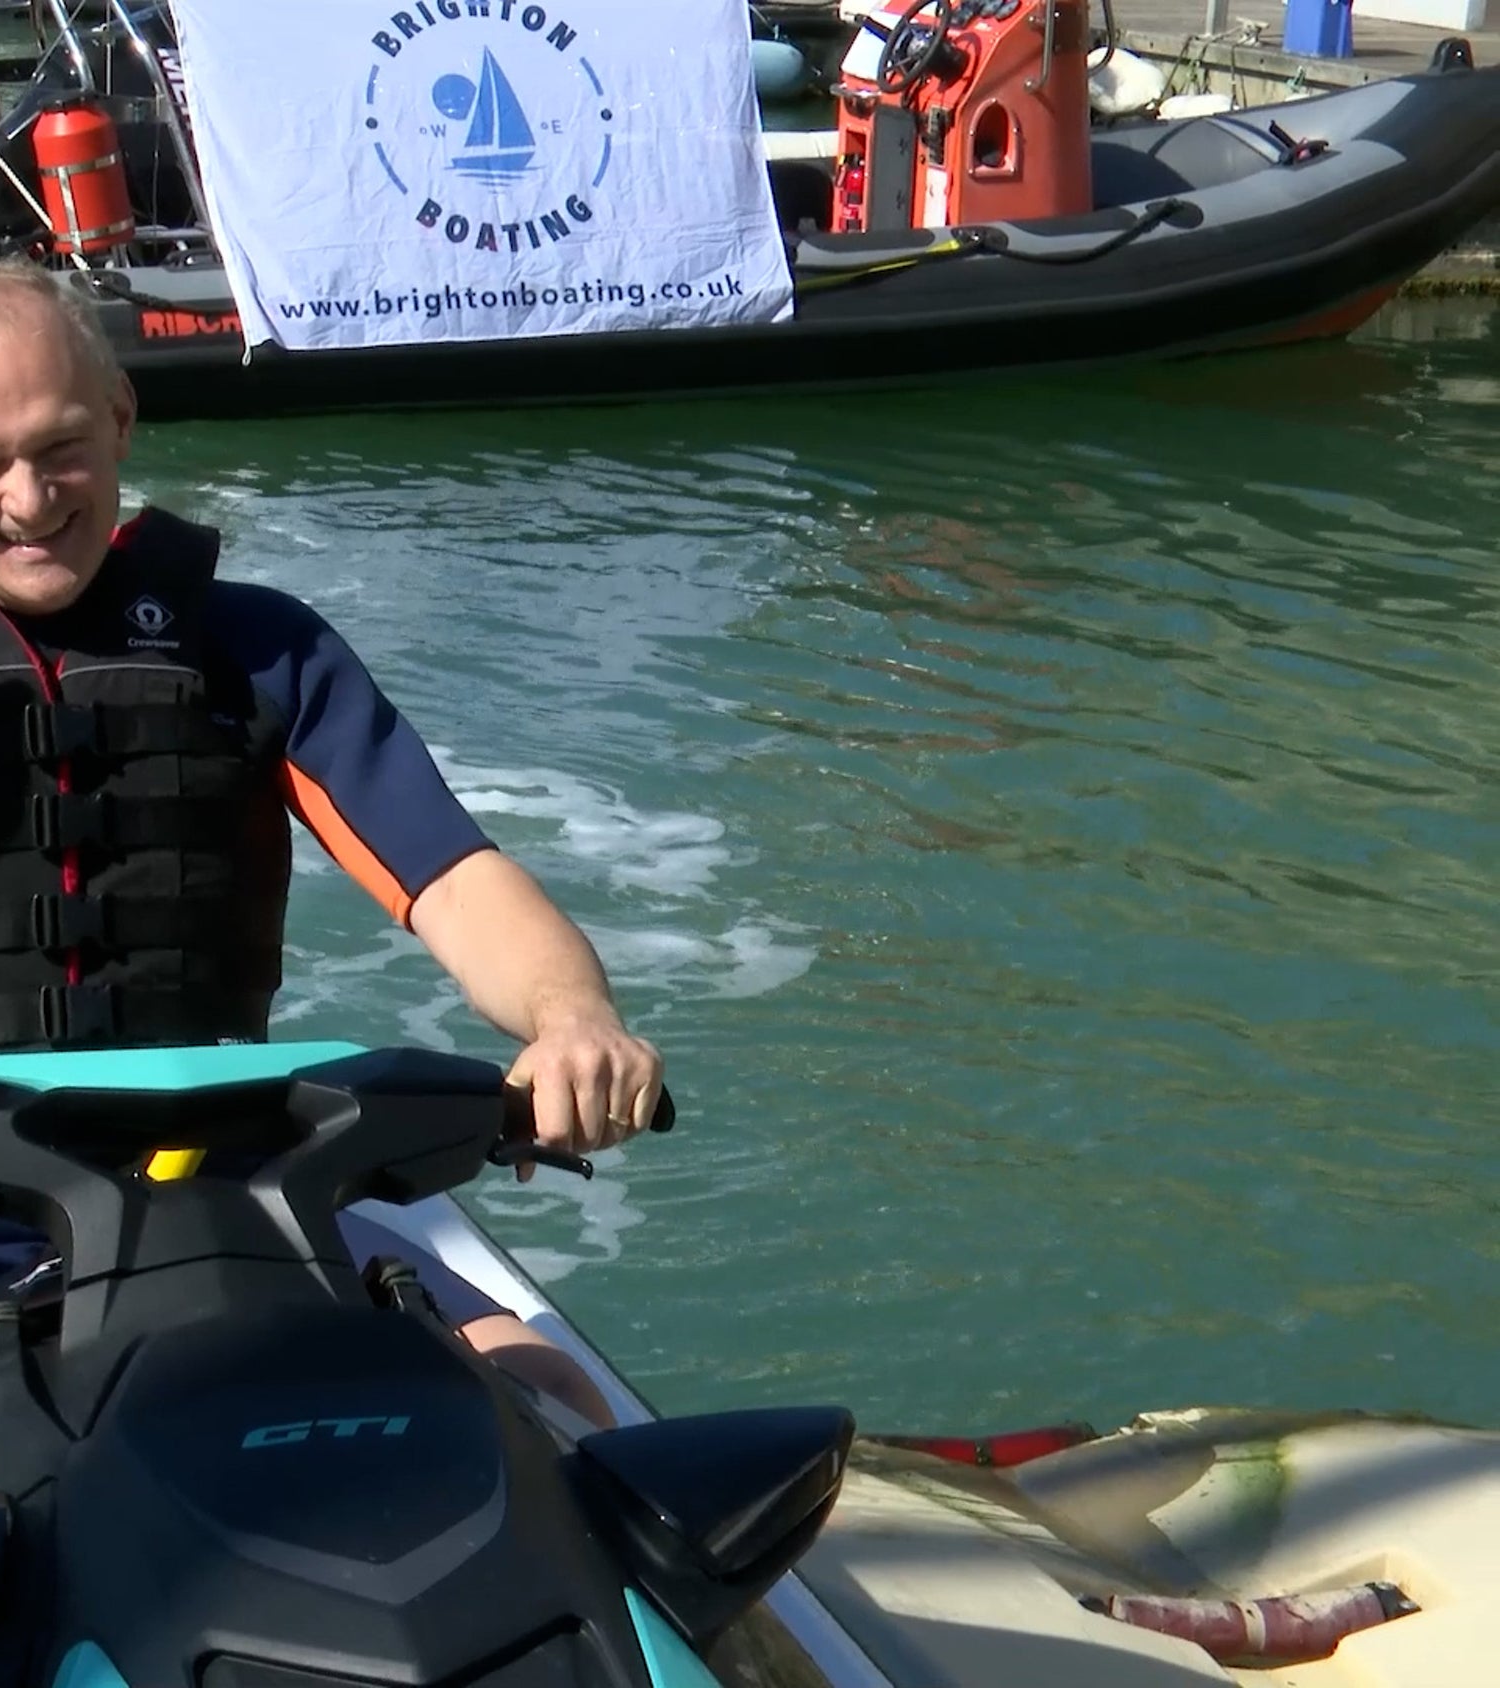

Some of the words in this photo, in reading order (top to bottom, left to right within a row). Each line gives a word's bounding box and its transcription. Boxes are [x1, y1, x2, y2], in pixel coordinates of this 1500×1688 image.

[371, 0, 577, 57] BRIGHTON
[416, 194, 593, 253] BOATING
[280, 274, 744, 319] www.brightonboating.co.uk
[241, 1416, 411, 1449] GTI
